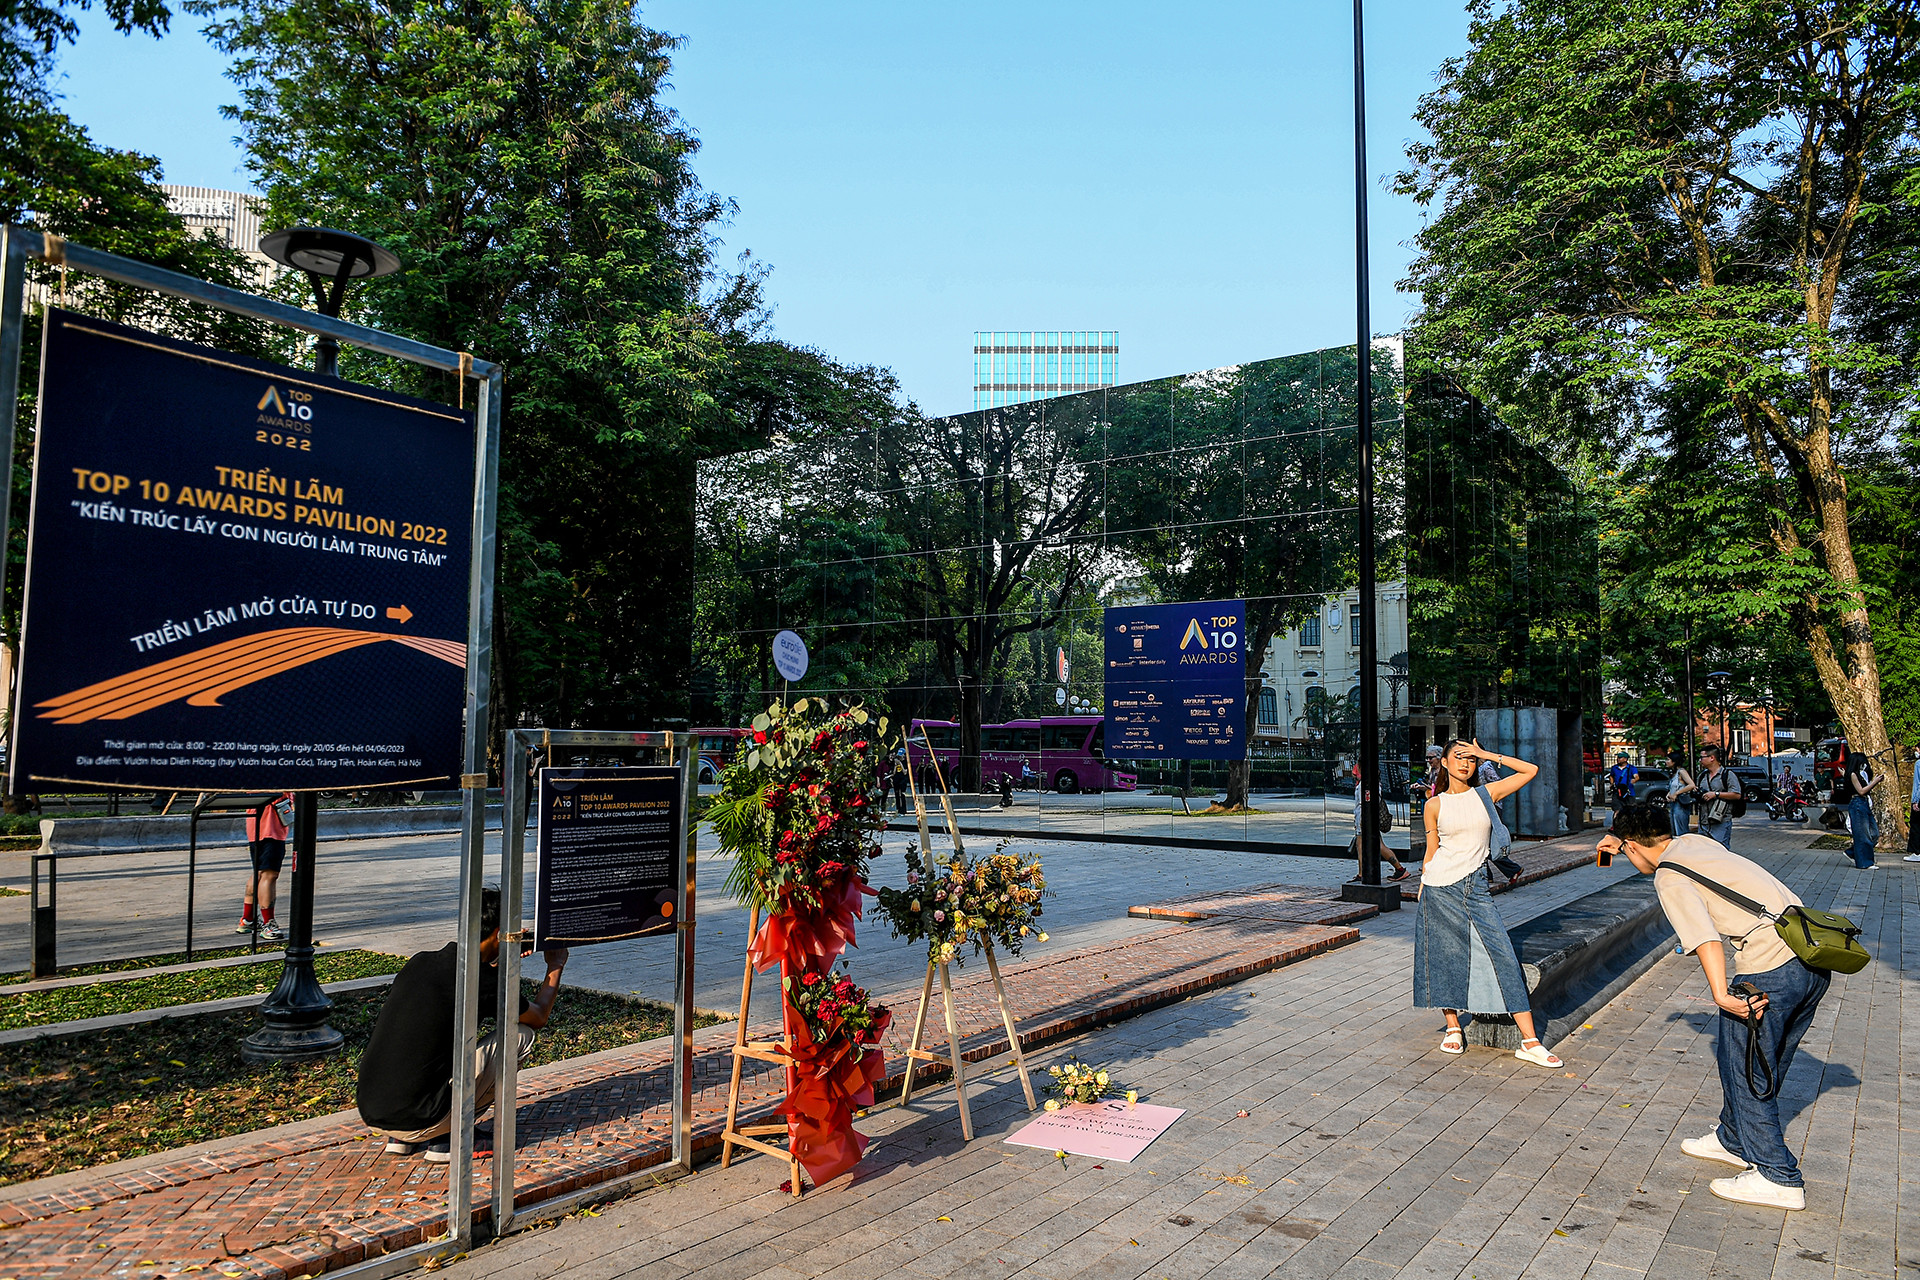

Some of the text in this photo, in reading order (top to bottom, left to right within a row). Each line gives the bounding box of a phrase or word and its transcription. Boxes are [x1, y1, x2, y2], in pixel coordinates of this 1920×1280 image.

[288, 389, 313, 403] TOP
[287, 402, 313, 420] 10
[256, 414, 312, 434] AWARDS
[255, 430, 311, 452] 2022
[214, 465, 344, 505] TRIỂN LÃM
[72, 468, 447, 545] TOP 10 AWARDS PAVILION 2022
[129, 509, 180, 530] TRÚC
[183, 514, 218, 535] LẤY
[220, 523, 259, 541] CON
[263, 529, 317, 549] NGƯỜI
[322, 535, 354, 554] LÀM
[358, 542, 408, 561] TRUNG
[130, 594, 376, 653] TRIỂN LÃM MỞ CỬA TỰ DO
[1210, 616, 1237, 628] TOP
[1210, 631, 1237, 649] 10
[1179, 652, 1238, 665] AWARDS
[126, 740, 147, 751] gian
[185, 741, 204, 750] 8:00
[212, 742, 235, 750] 22:00
[237, 742, 257, 753] hàng
[293, 743, 312, 753] ngày
[313, 743, 335, 752] 20/05
[336, 743, 351, 752] đến
[365, 745, 405, 753] 04/06/2023
[150, 756, 168, 765] hoa
[217, 756, 236, 768] (hay
[261, 757, 277, 766] hoa
[278, 757, 294, 766] Con
[316, 758, 337, 768] Tràng
[357, 758, 376, 766] Hoàn
[398, 758, 408, 766] Hà
[602, 802, 629, 810] AWARDS
[629, 801, 656, 809] PAVILION
[656, 800, 670, 808] 2022
